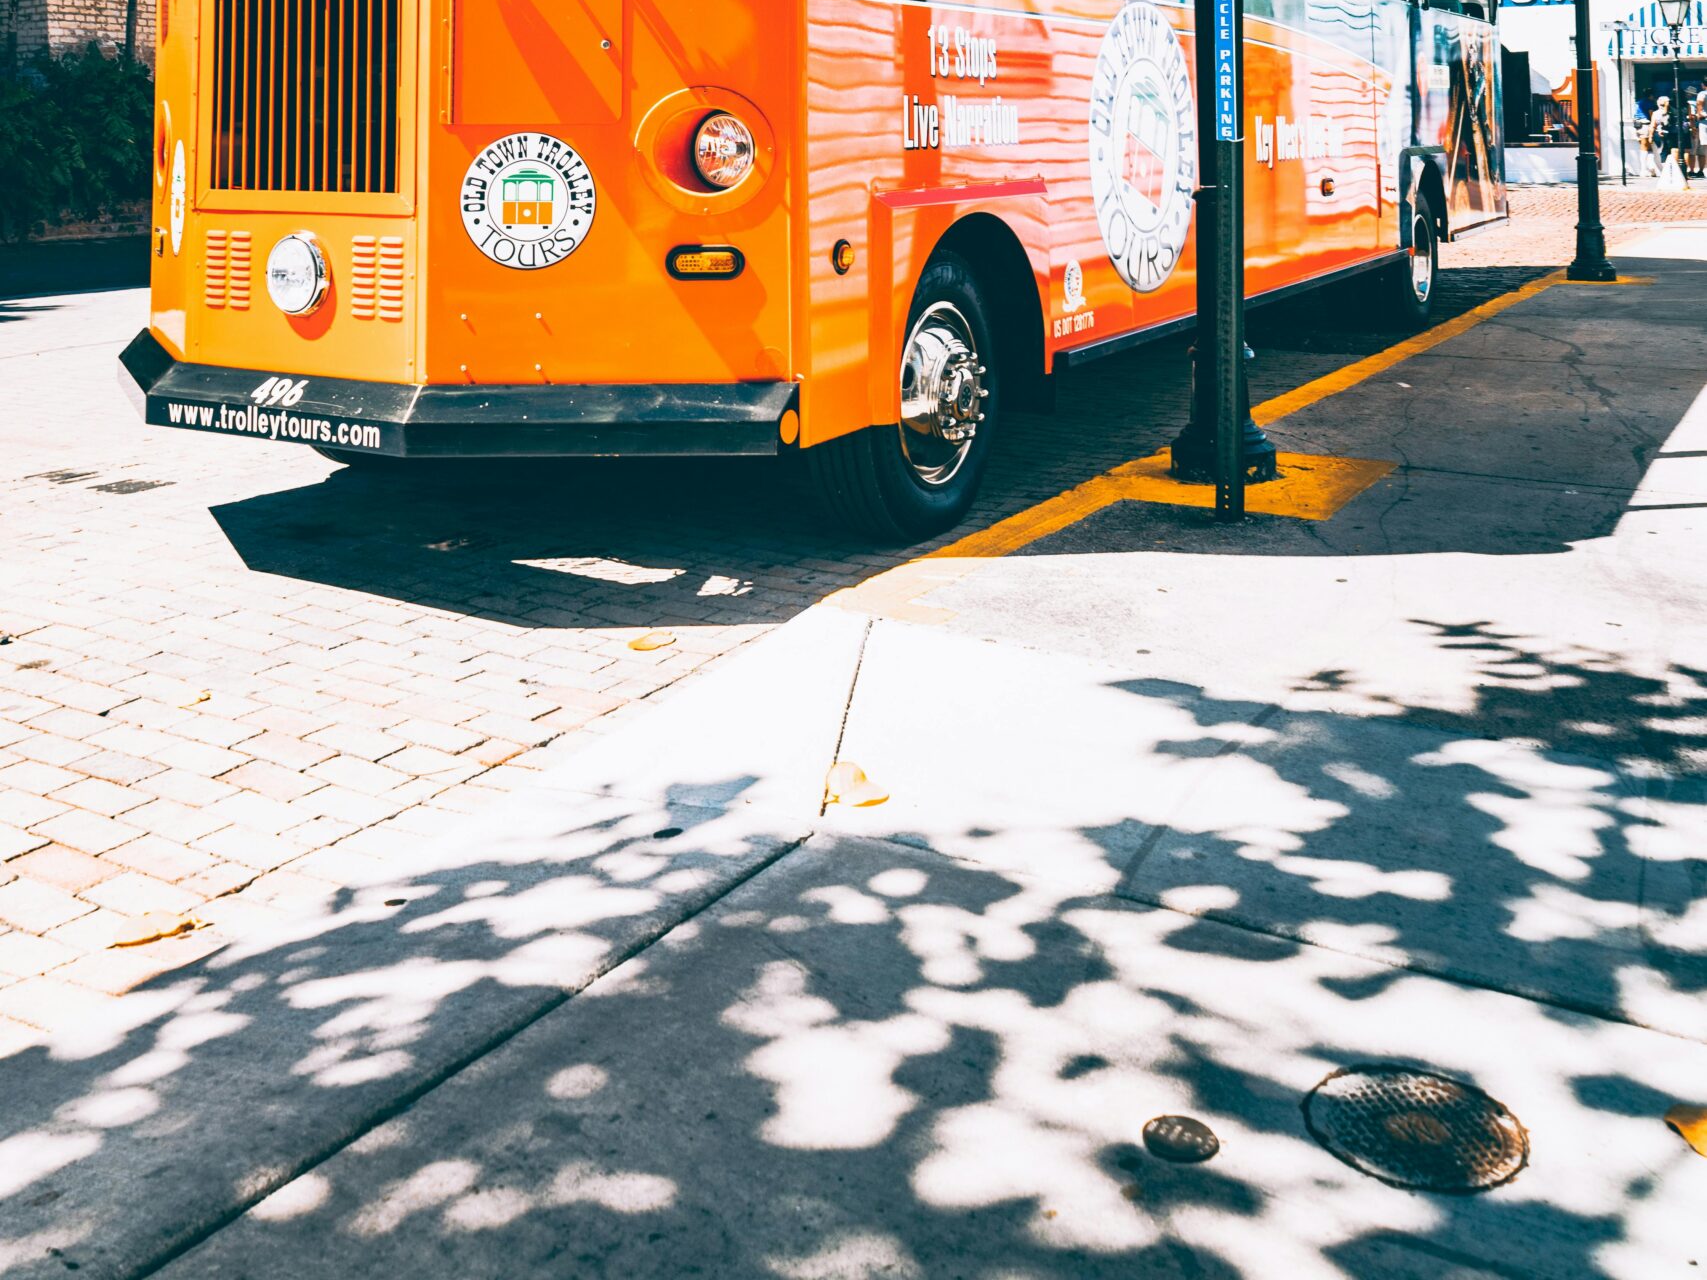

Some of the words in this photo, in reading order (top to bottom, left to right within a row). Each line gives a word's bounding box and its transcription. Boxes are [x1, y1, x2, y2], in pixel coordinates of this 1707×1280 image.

[927, 24, 949, 78] 13
[954, 26, 998, 87] Stops
[1091, 53, 1118, 138] OLD
[1161, 30, 1195, 210] TROLLEY
[1219, 49, 1233, 138] PARKING
[903, 95, 940, 150] Live
[943, 94, 1020, 148] Narration
[1254, 115, 1274, 171] Key
[475, 135, 528, 176] TOWN
[536, 135, 594, 215] TROLLEY
[463, 176, 488, 213] OLD
[479, 224, 576, 267] TOURS
[250, 376, 310, 407] 496
[168, 403, 381, 449] www.trolleytours.com
